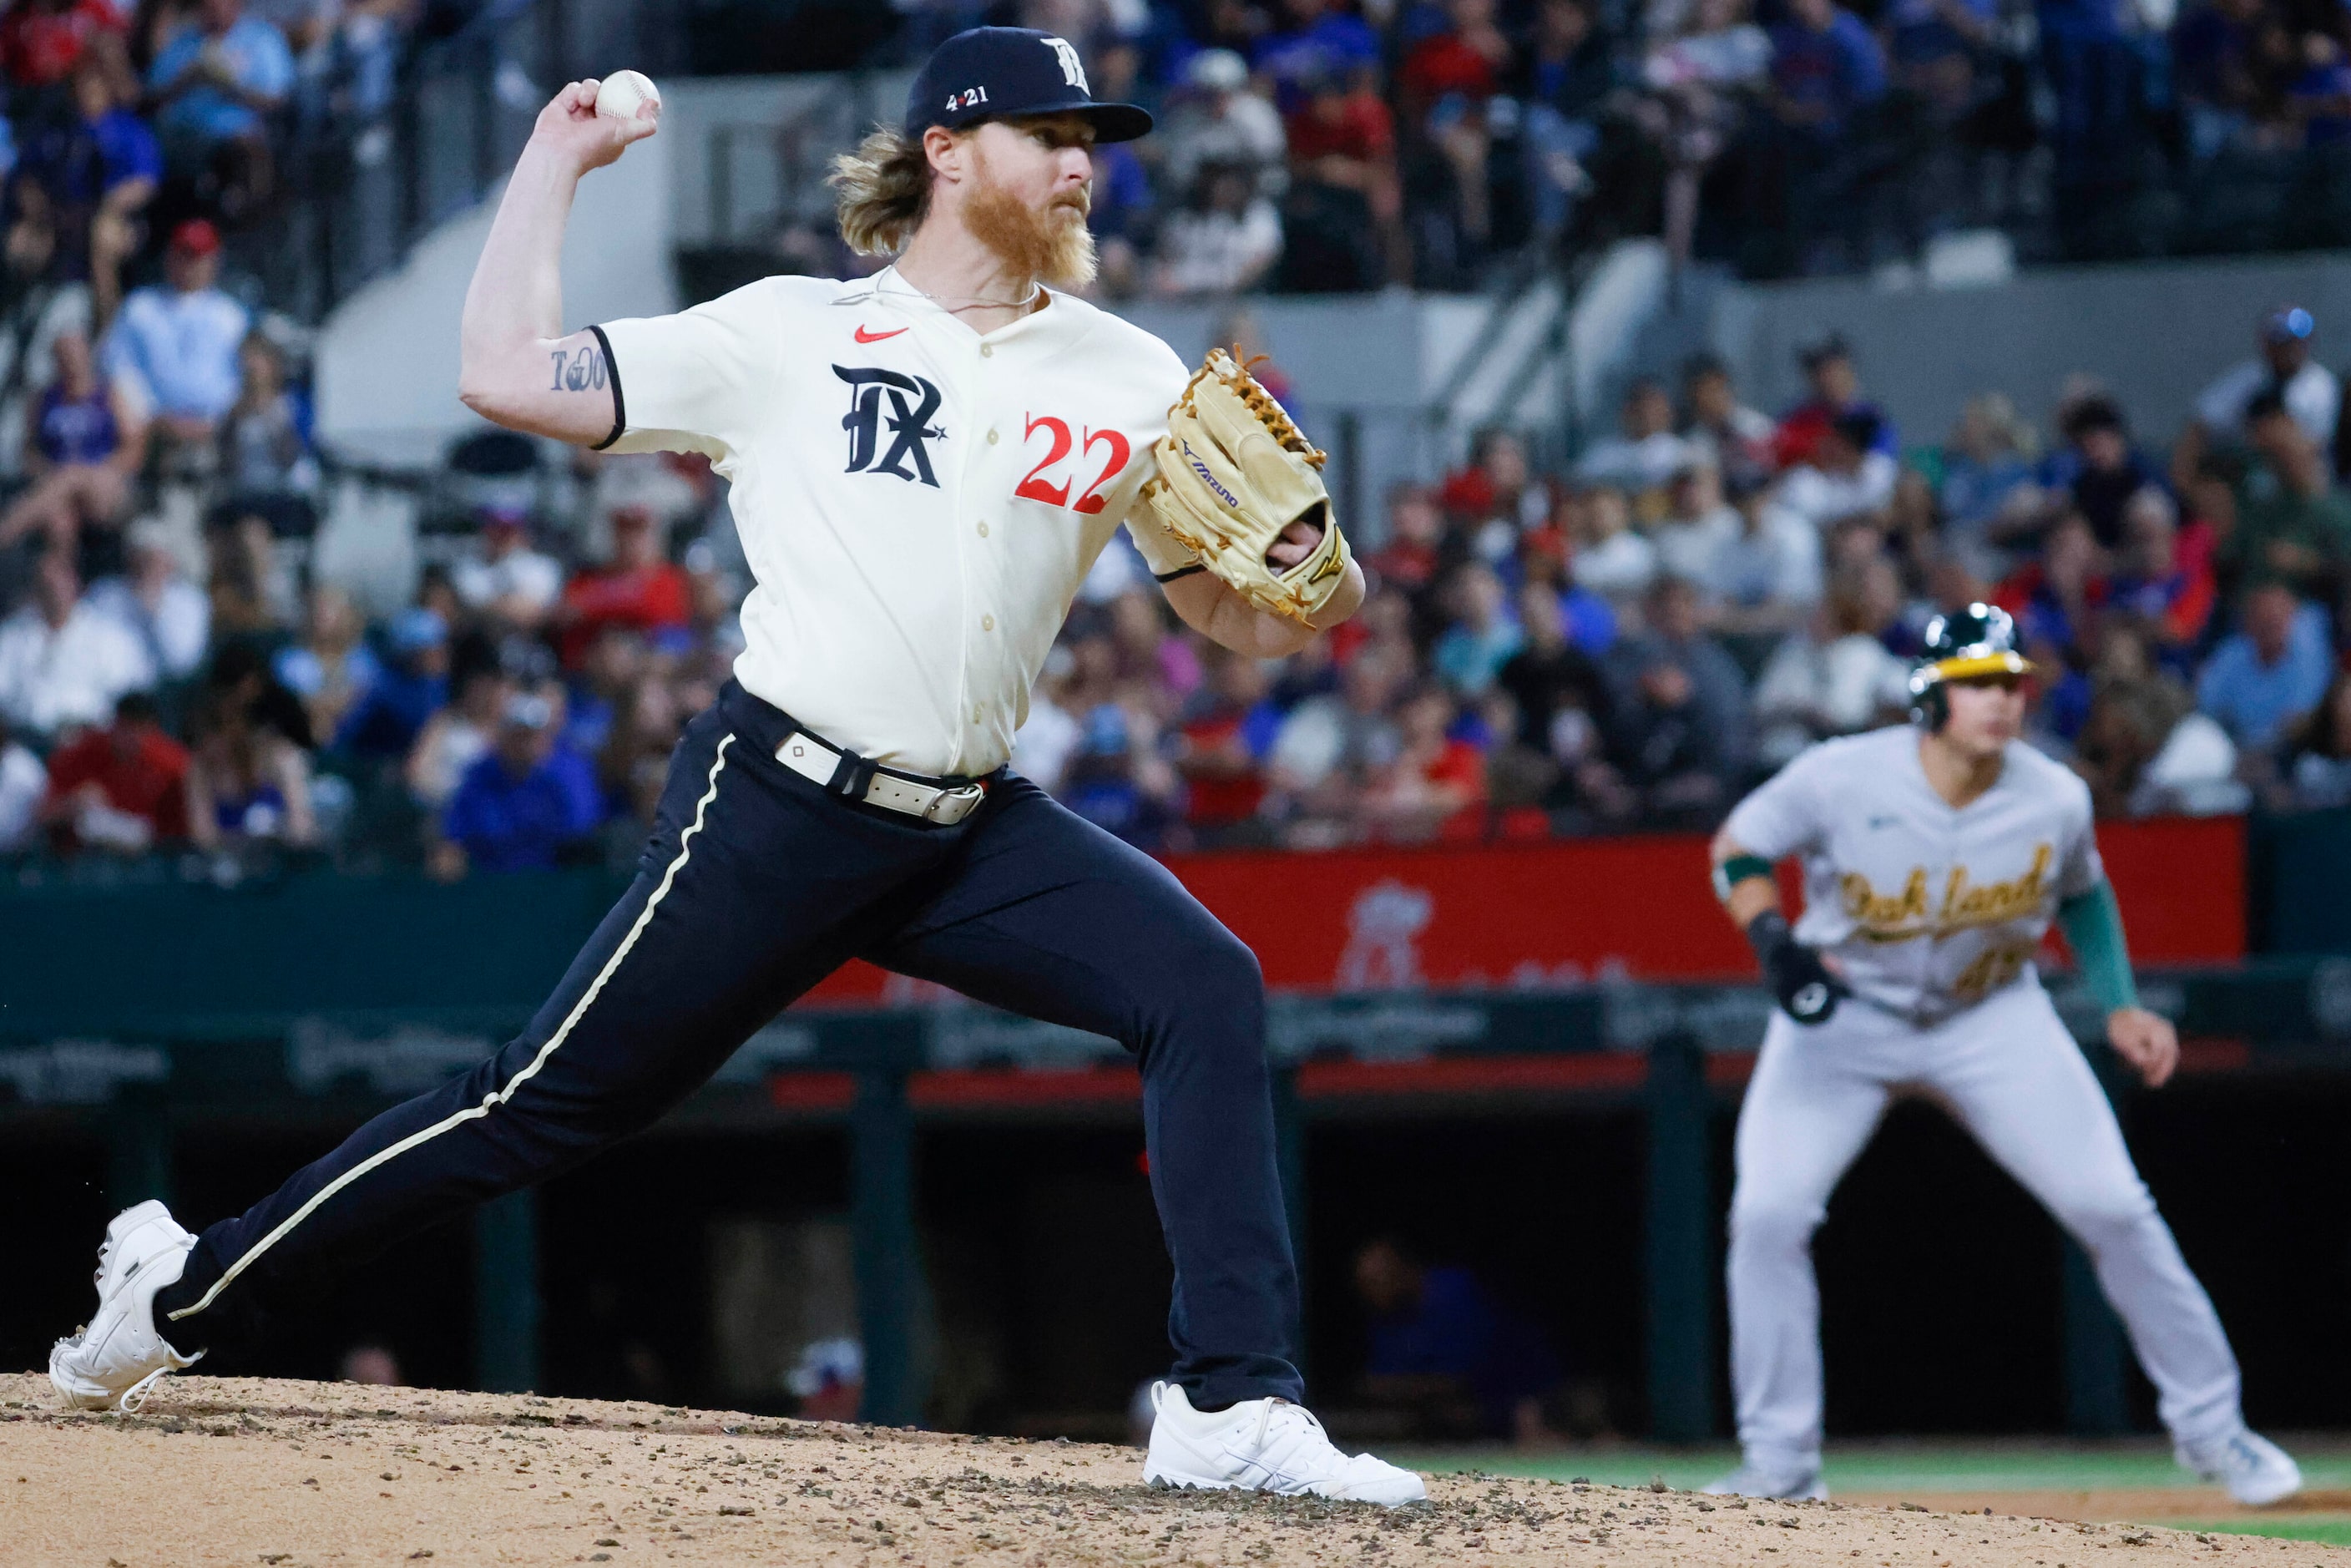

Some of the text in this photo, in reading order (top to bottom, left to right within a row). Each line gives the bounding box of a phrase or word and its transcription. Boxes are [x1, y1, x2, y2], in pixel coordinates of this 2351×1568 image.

[1014, 411, 1131, 515] 22
[1191, 461, 1239, 508] MIZUNO
[1840, 844, 2052, 922] Oakland
